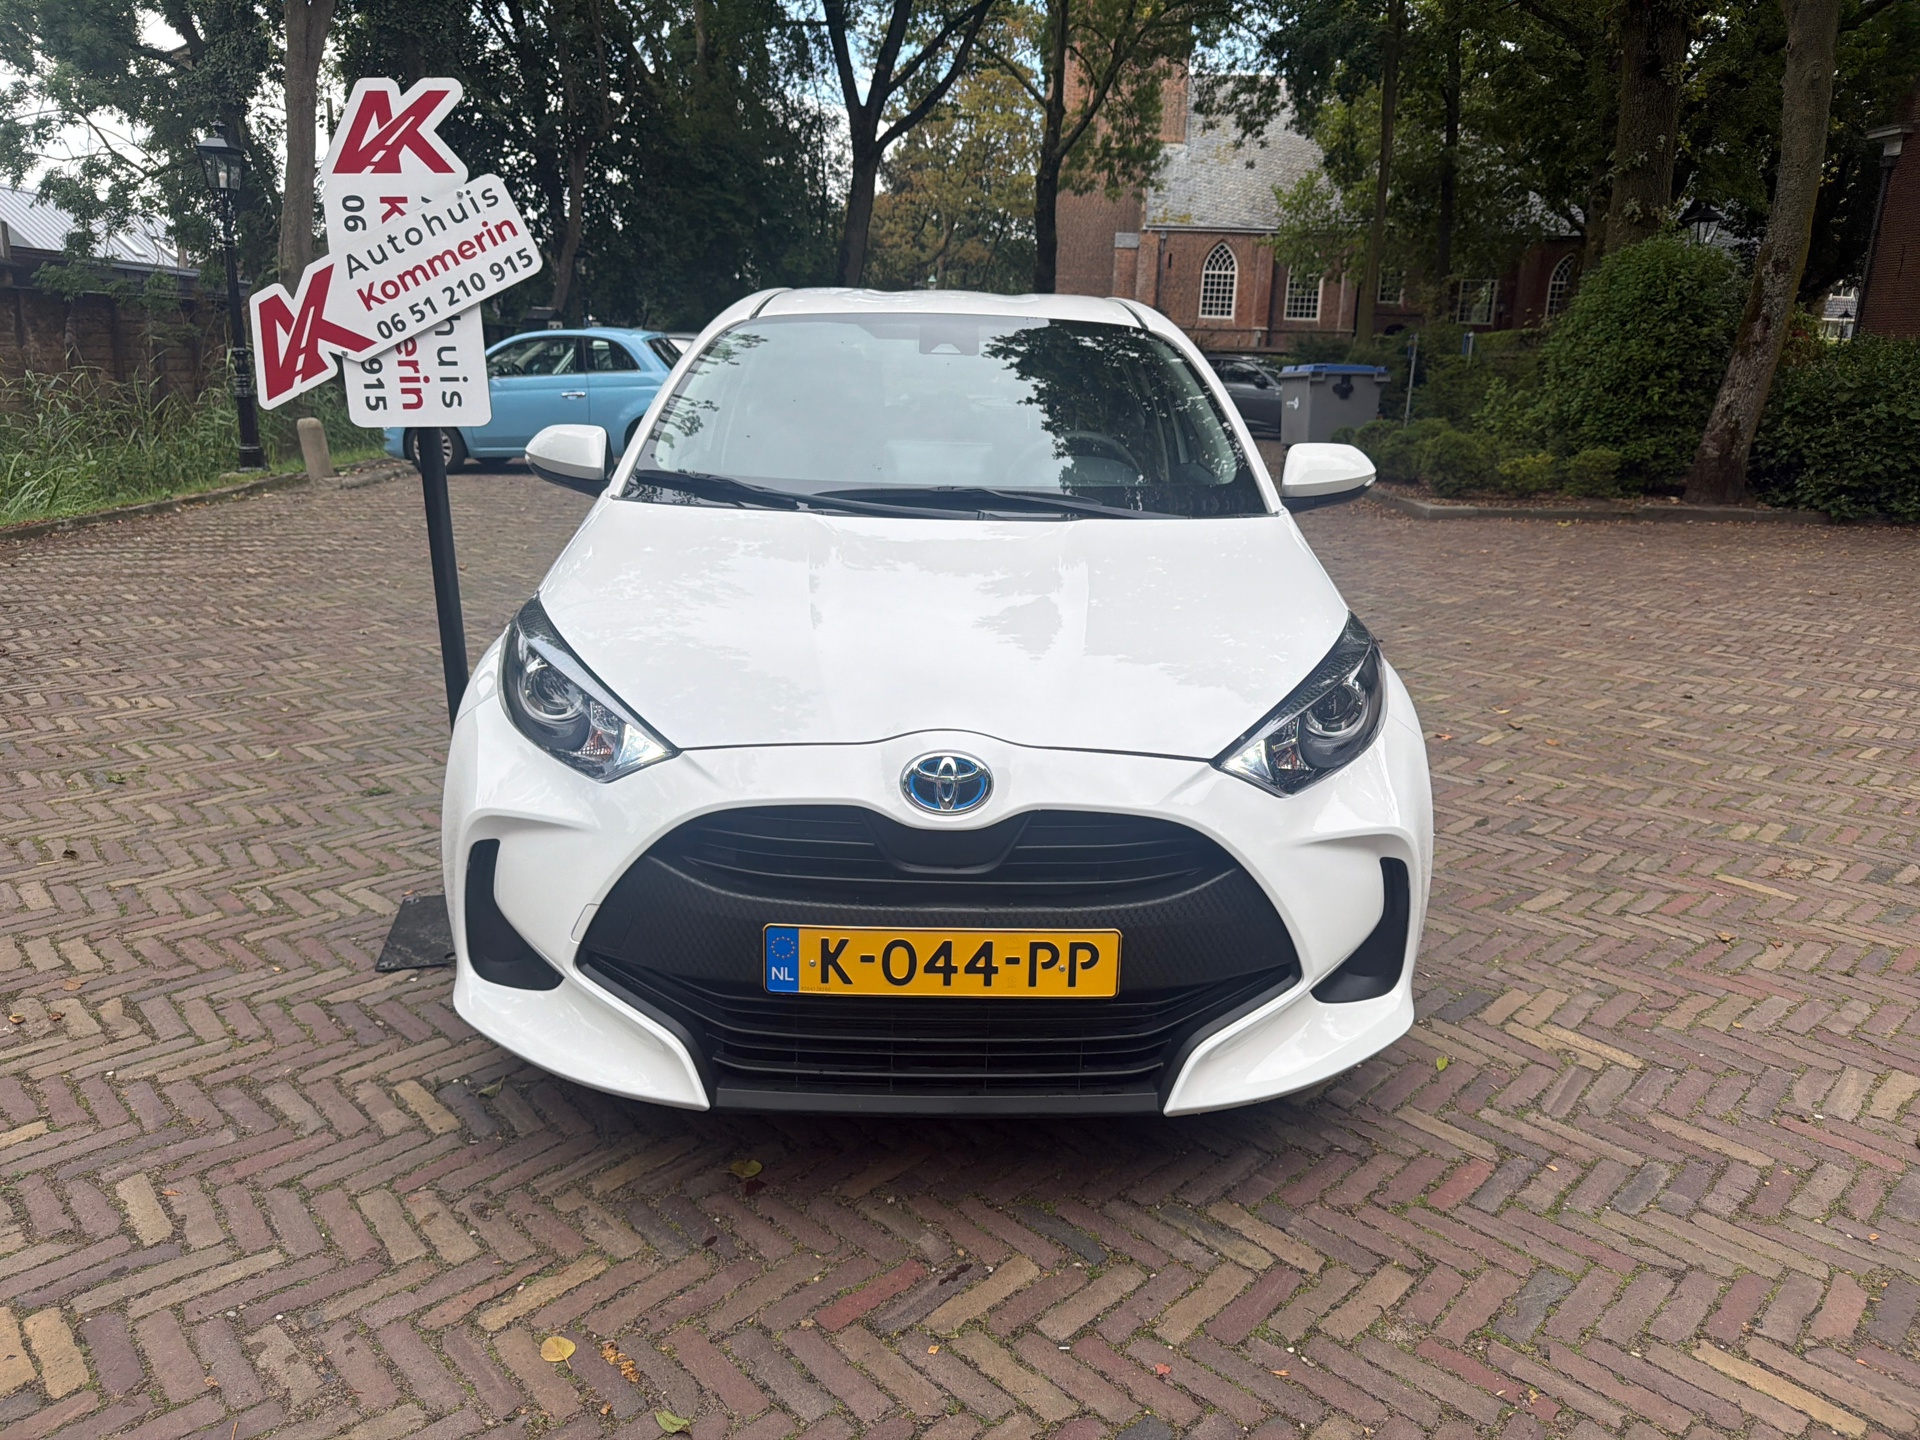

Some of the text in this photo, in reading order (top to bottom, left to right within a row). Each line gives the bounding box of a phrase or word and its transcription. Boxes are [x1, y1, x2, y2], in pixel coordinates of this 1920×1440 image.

[346, 187, 499, 280] Autohuis
[357, 219, 519, 312] Kommerin
[341, 194, 388, 411] 06 915
[376, 247, 533, 339] 06 51 210 915
[771, 937, 1100, 988] NL K-044-PP
